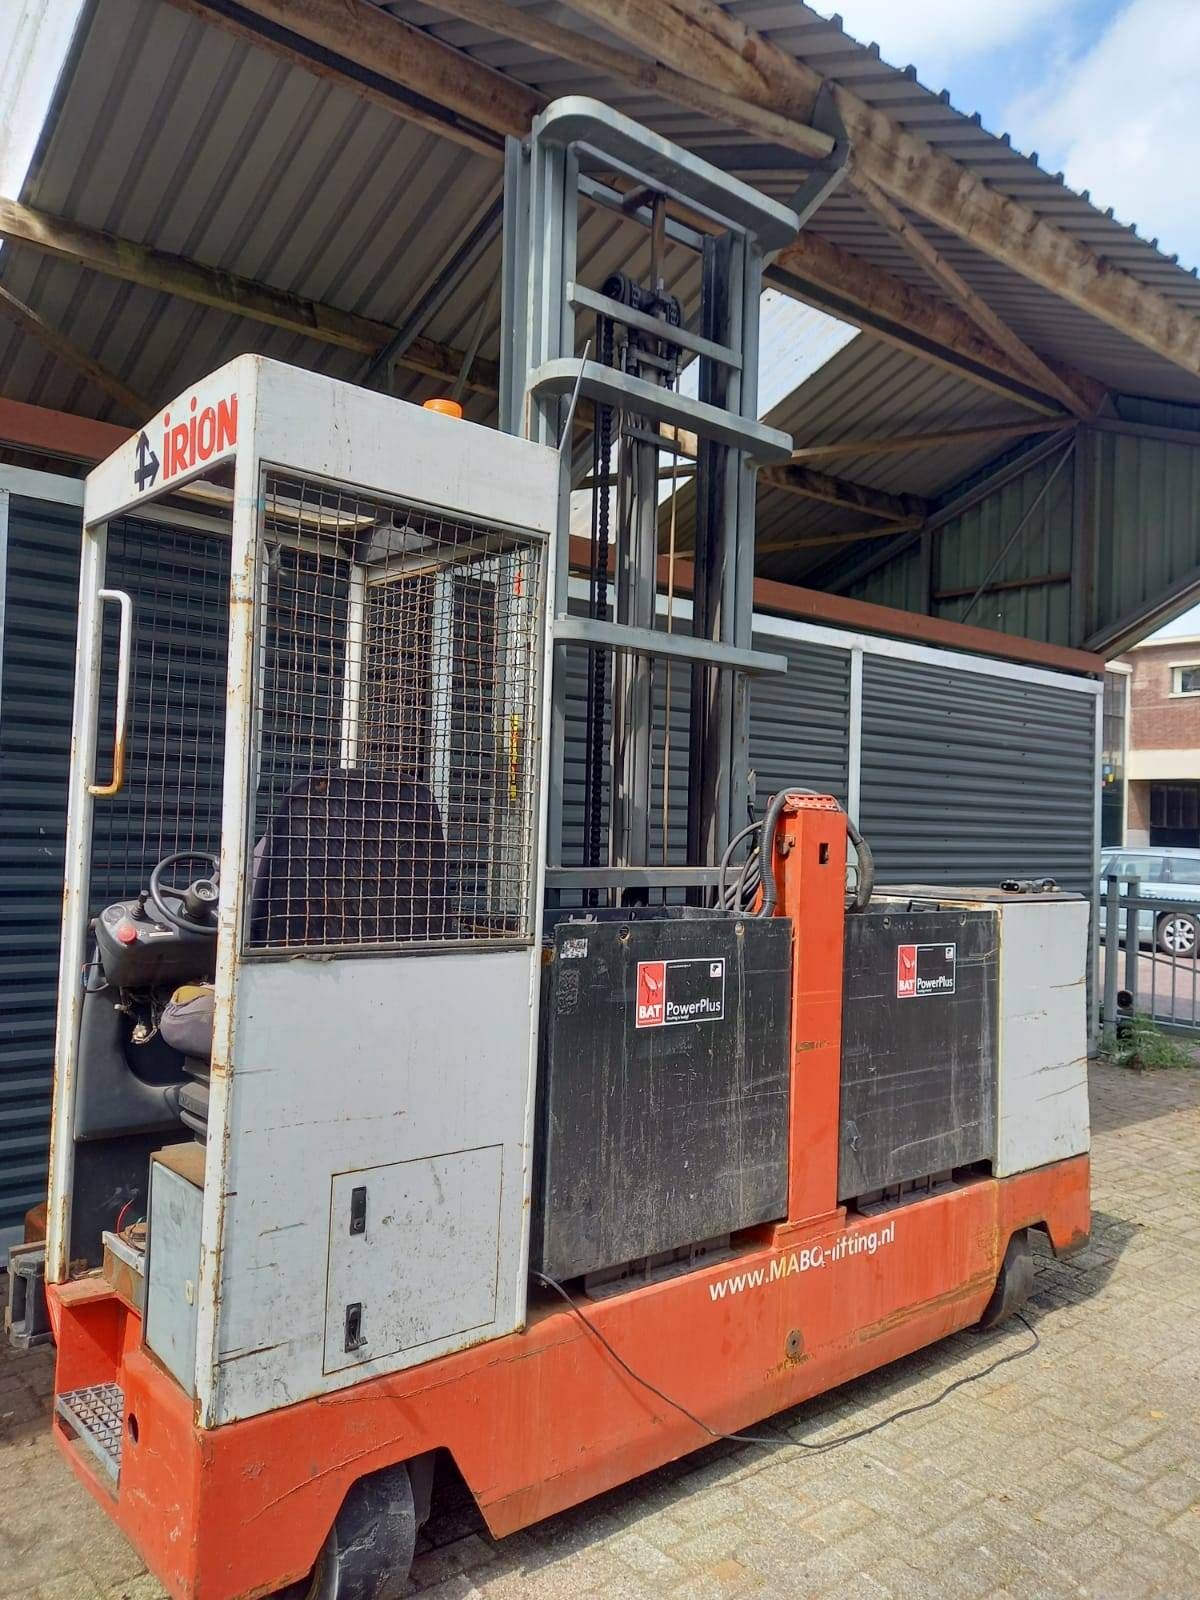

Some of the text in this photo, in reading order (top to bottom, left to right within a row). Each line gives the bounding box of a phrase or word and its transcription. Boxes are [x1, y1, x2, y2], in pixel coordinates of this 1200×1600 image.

[899, 980, 914, 991] BAT
[917, 976, 953, 990] PowerPlus
[639, 1004, 662, 1020] BAT
[666, 998, 721, 1016] PowerPlus
